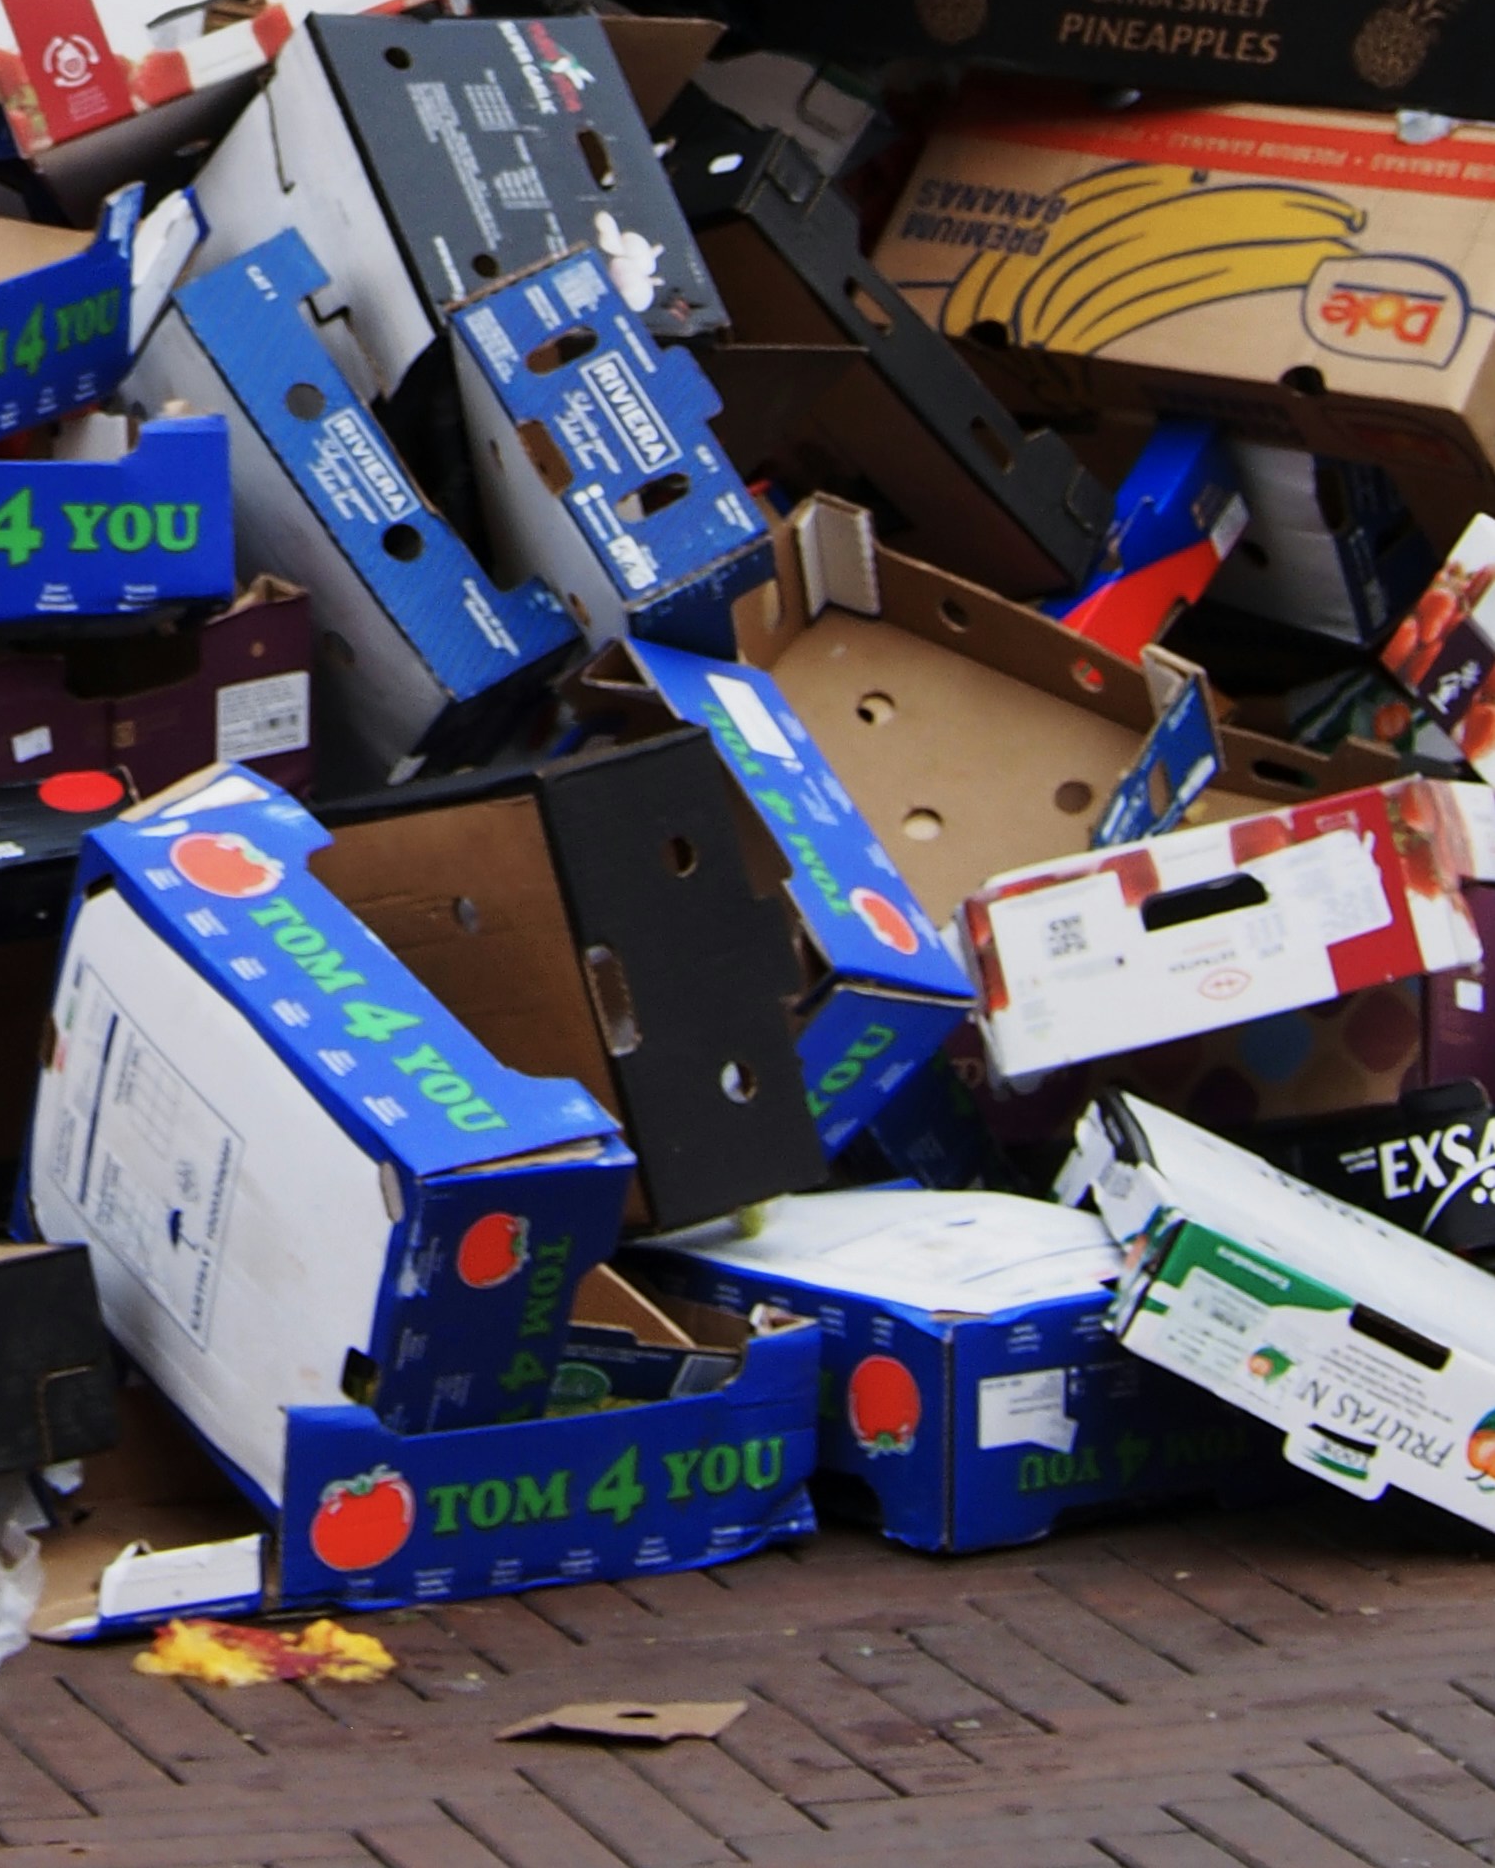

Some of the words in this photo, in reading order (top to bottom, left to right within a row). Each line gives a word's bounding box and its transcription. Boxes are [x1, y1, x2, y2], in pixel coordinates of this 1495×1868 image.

[1057, 12, 1283, 65] PINEAPPLES
[902, 210, 1050, 256] PREMIUM
[918, 178, 1067, 224] BANANAS
[13, 301, 47, 376] 4
[54, 288, 122, 354] YOU
[1318, 290, 1444, 346] Dole
[593, 360, 668, 464] RIVIERA
[332, 416, 407, 514] RIVIERA
[60, 502, 202, 553] YOU
[752, 787, 798, 826] 4
[785, 832, 855, 917] TOM
[247, 894, 368, 995] TOM
[340, 999, 425, 1044] 4
[390, 1043, 510, 1133] YOU
[518, 1235, 573, 1338] TOM
[500, 1350, 547, 1394] 4
[1331, 1389, 1458, 1470] FRUTAS
[426, 1469, 572, 1534] TOM
[586, 1443, 647, 1525] 4
[662, 1435, 785, 1501] YOU
[1017, 1446, 1103, 1492] YOU
